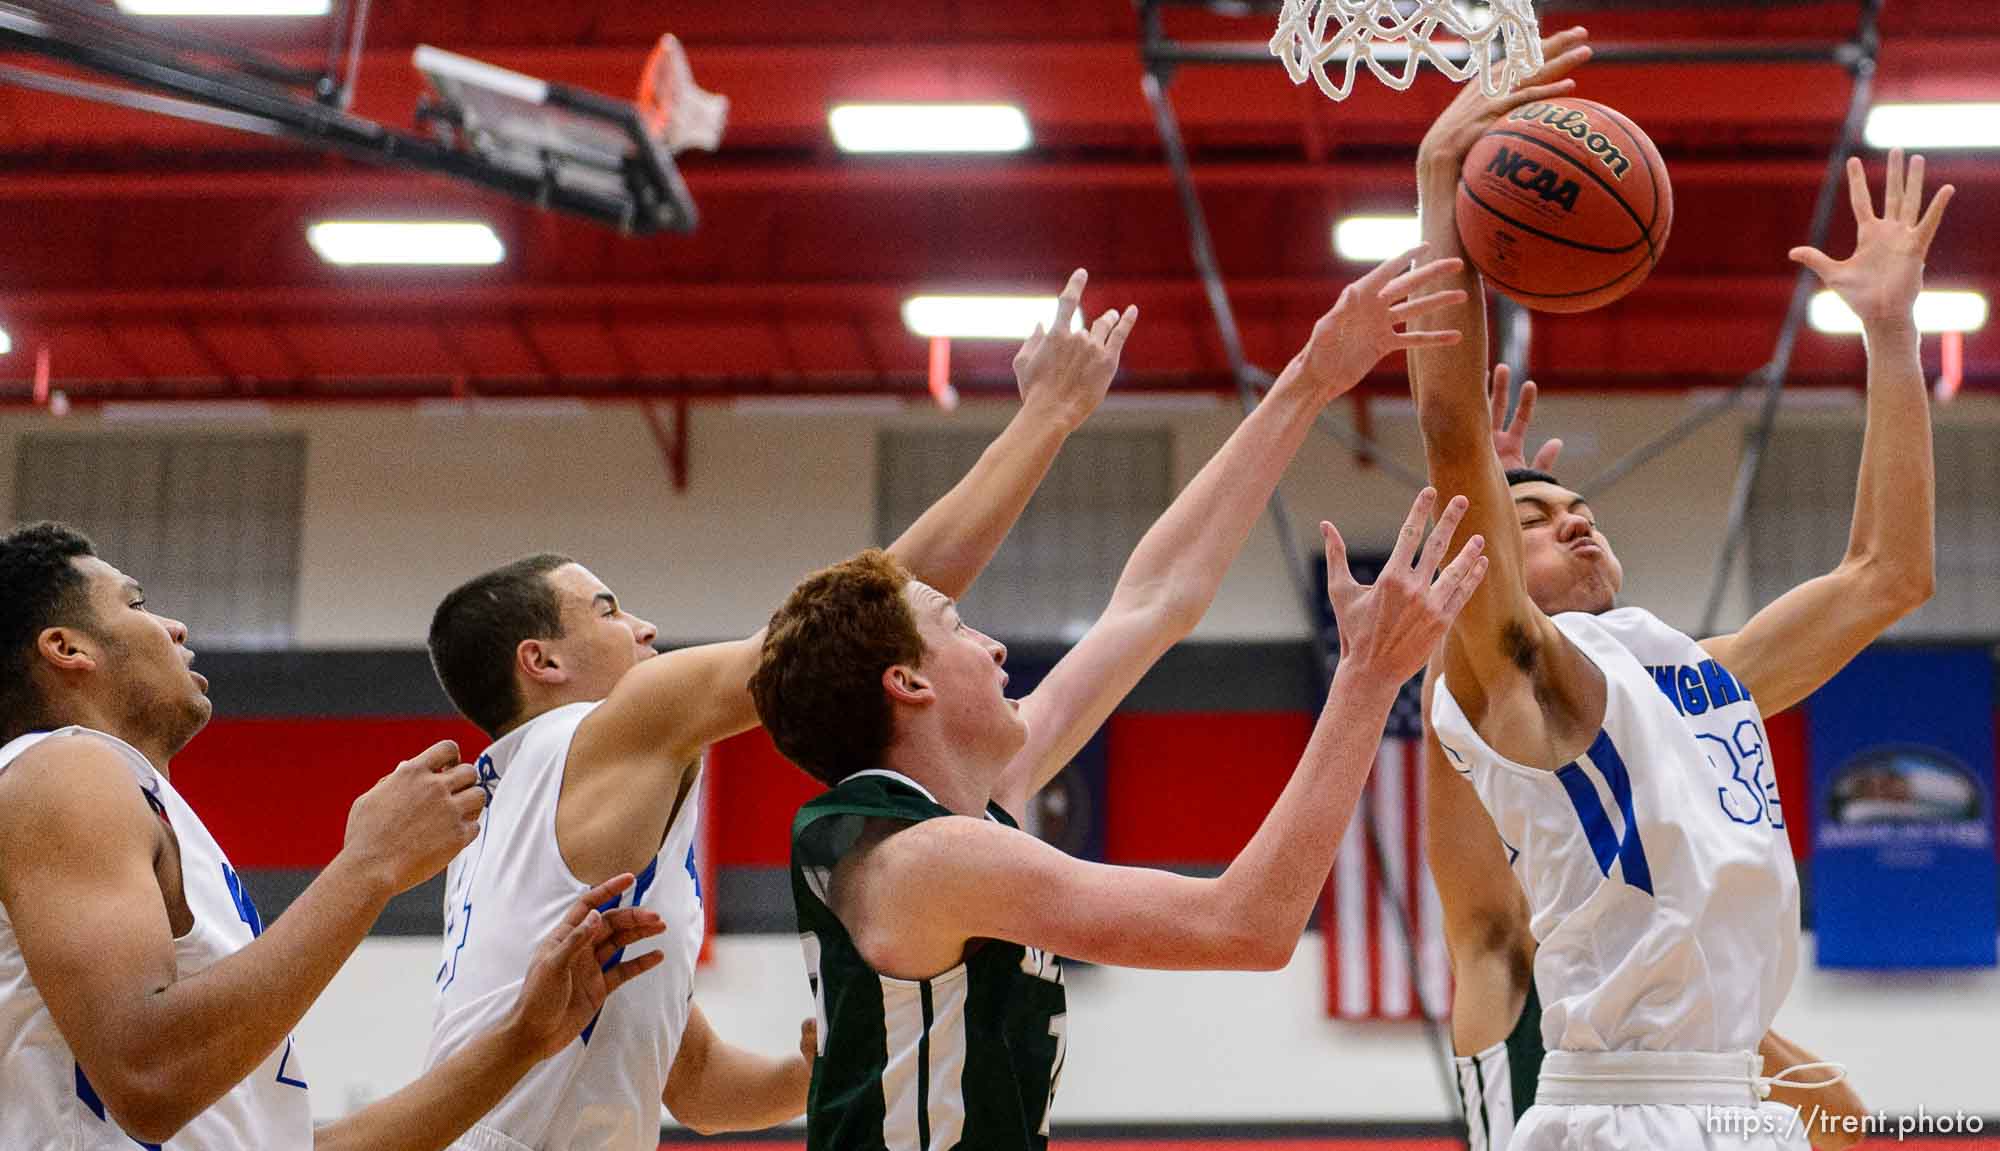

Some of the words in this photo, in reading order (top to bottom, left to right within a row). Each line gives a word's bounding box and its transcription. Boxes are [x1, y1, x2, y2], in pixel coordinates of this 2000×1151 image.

[1508, 103, 1631, 182] Wilson
[1487, 147, 1581, 212] NCAA
[1644, 658, 1752, 717] NGH
